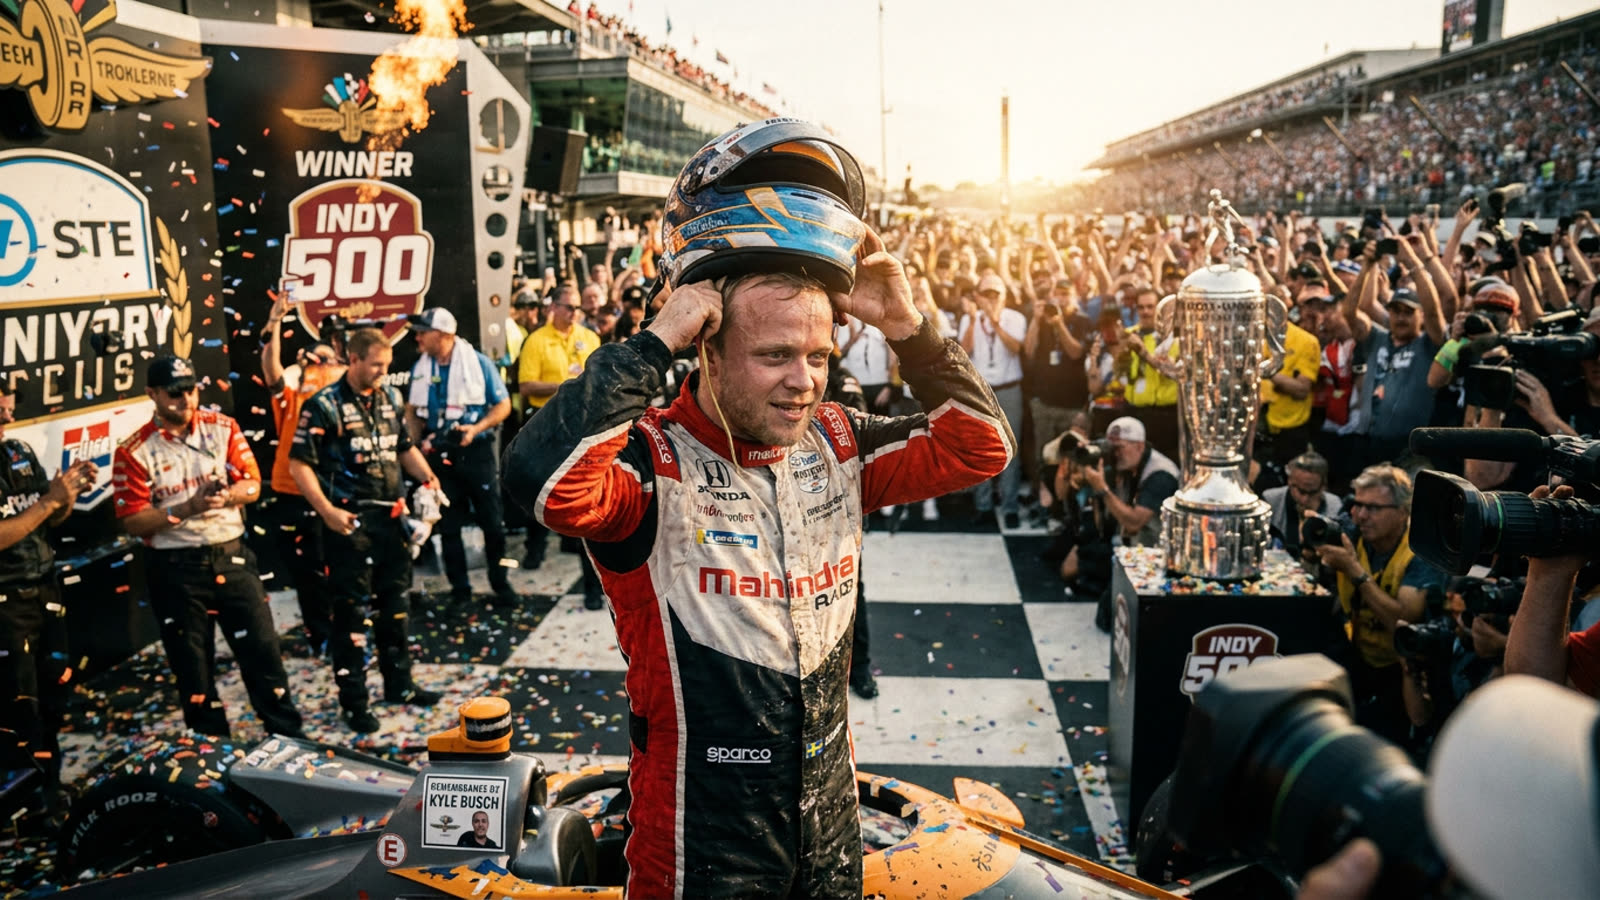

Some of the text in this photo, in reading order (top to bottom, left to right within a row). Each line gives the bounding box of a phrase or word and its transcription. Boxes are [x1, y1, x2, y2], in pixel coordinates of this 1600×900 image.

[295, 150, 414, 178] WINNER
[316, 202, 399, 234] INDY
[53, 219, 135, 259] STE
[283, 234, 429, 302] 500
[1208, 636, 1262, 654] INDY
[706, 746, 772, 764] sparco
[429, 794, 499, 810] KYLE BUSCH
[384, 840, 398, 861] E
